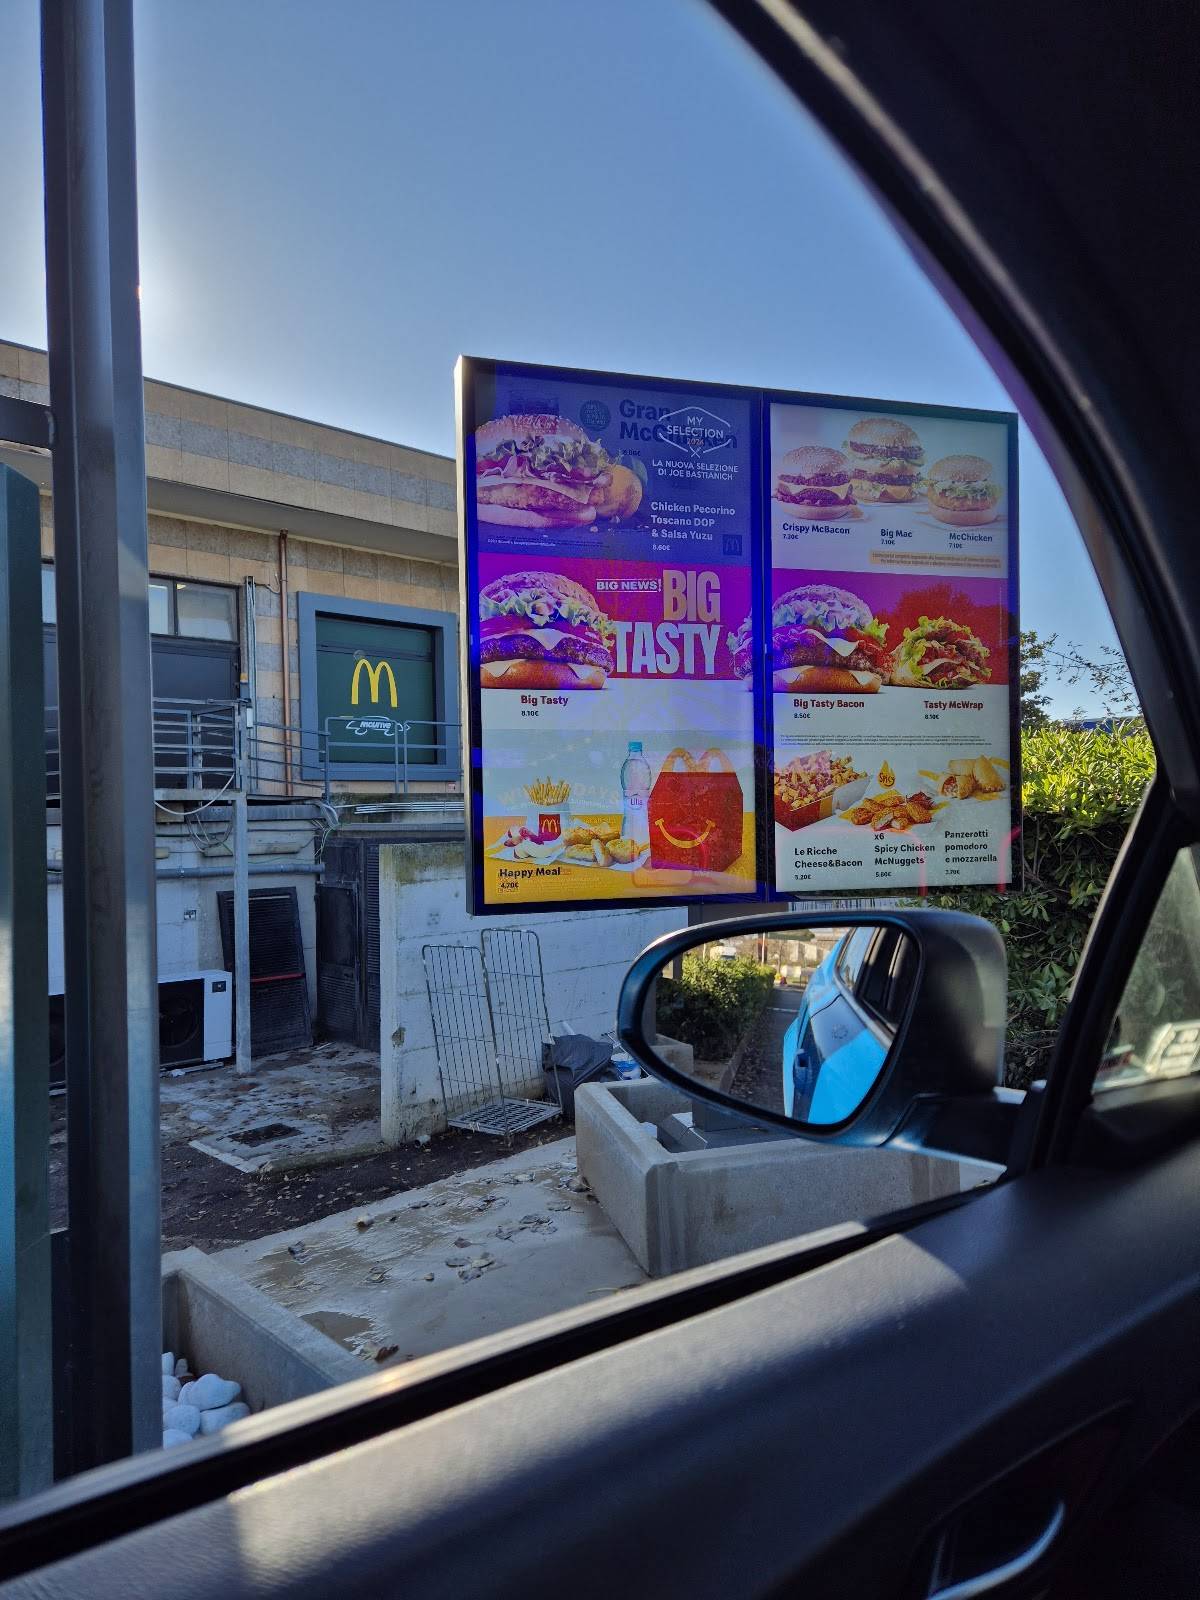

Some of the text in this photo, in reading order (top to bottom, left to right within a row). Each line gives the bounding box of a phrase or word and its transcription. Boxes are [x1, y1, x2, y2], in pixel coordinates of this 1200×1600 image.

[619, 399, 671, 421] Gran
[687, 415, 704, 426] MY
[666, 425, 724, 439] SELECTION
[652, 459, 739, 473] LA NUOVA SELEZIONE
[658, 468, 733, 481] DI JOE BASTIANICH
[650, 501, 736, 516] Chicken Pecorino
[650, 514, 716, 527] Toscano DOP
[651, 528, 713, 541] & Salsa Yuzu
[782, 522, 851, 535] Crispy McBacon
[880, 528, 913, 539] Big Mac
[949, 532, 993, 543] McChicken
[596, 579, 663, 592] BIG NEWS!
[663, 569, 721, 623] BIG
[613, 620, 724, 675] TASTY
[520, 694, 569, 707] Big Tasty
[793, 698, 865, 710] Big Tasty Bacon
[924, 700, 984, 711] Tasty McWrap
[874, 832, 885, 841] x6
[944, 829, 989, 839] Panzerotti
[794, 846, 838, 856] Le Ricche
[874, 843, 936, 854] Spicy Chicken
[944, 842, 988, 853] pomodoro
[794, 858, 863, 869] Cheese&Bacon
[874, 856, 925, 867] McNuggets
[952, 854, 998, 863] mozzarella
[499, 867, 561, 879] Happy Meal
